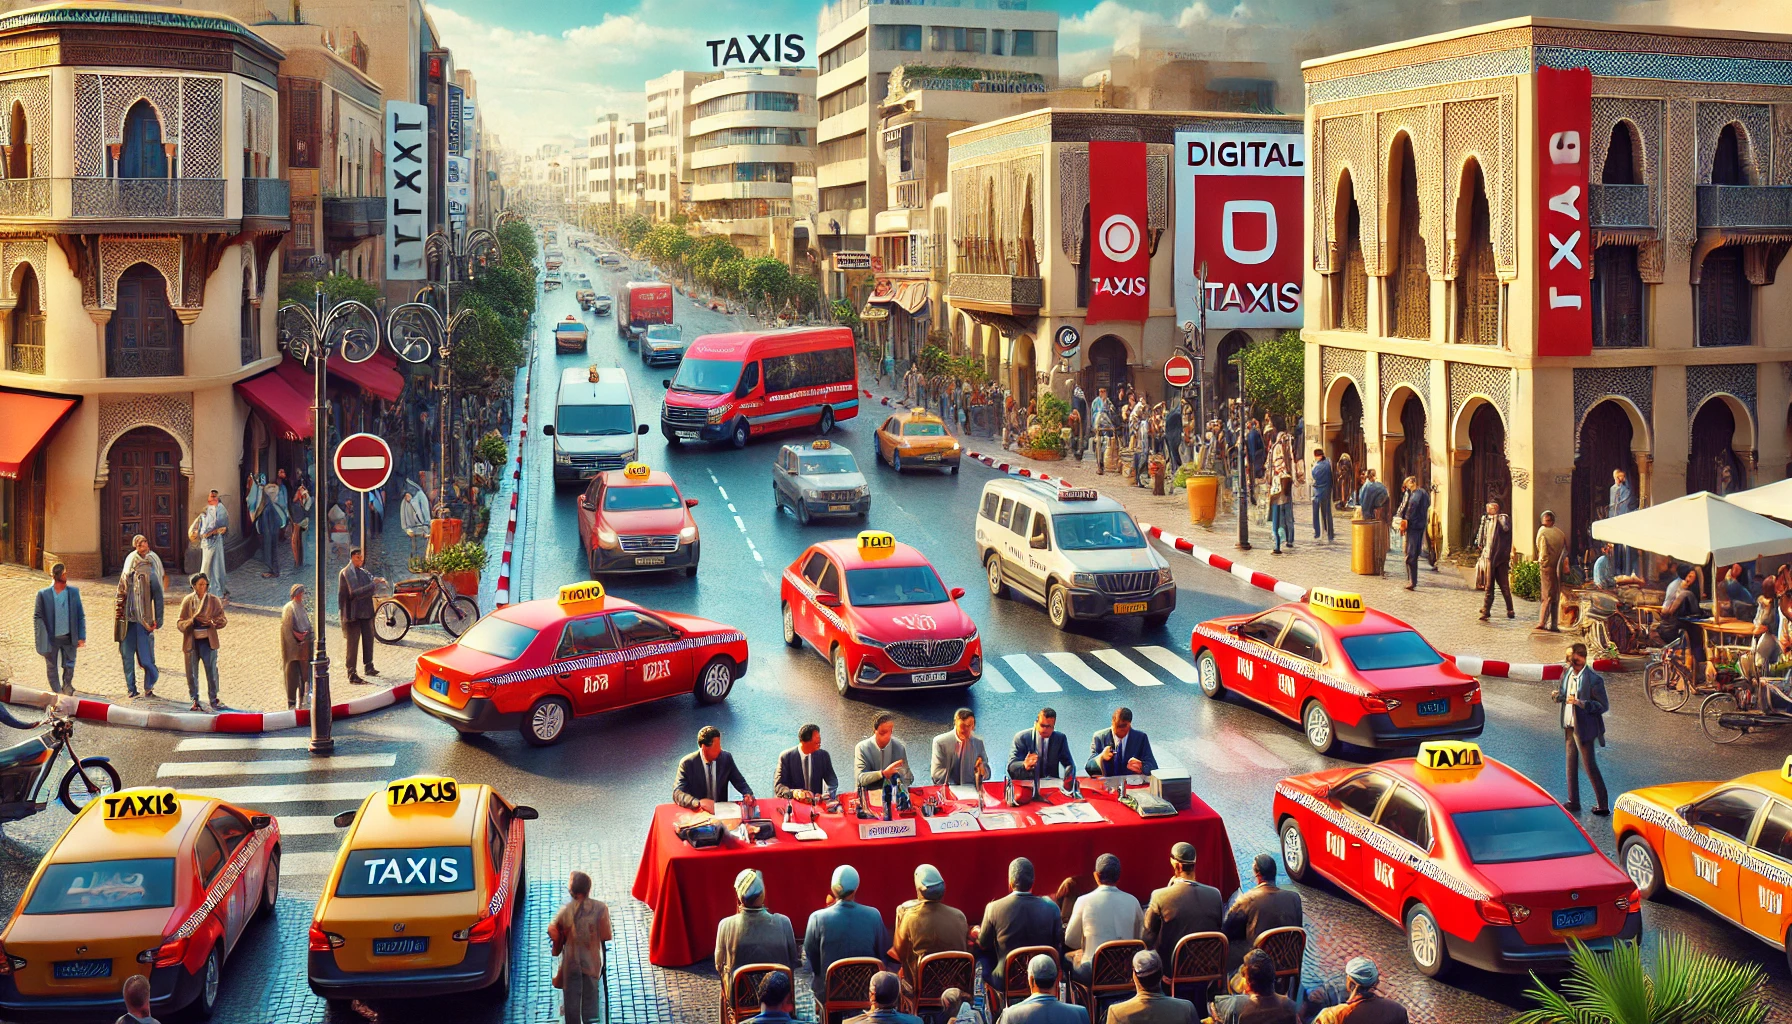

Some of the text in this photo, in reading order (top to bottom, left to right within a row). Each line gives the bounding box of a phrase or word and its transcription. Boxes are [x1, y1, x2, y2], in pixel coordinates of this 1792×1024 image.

[706, 33, 805, 67] TAXIS
[1187, 141, 1304, 168] DIGITAL
[1091, 276, 1147, 297] TAXIS
[1203, 281, 1302, 314] TAXIS
[104, 793, 178, 819] TAXIS
[388, 780, 457, 806] TAXIS
[364, 856, 459, 885] TAXIS
